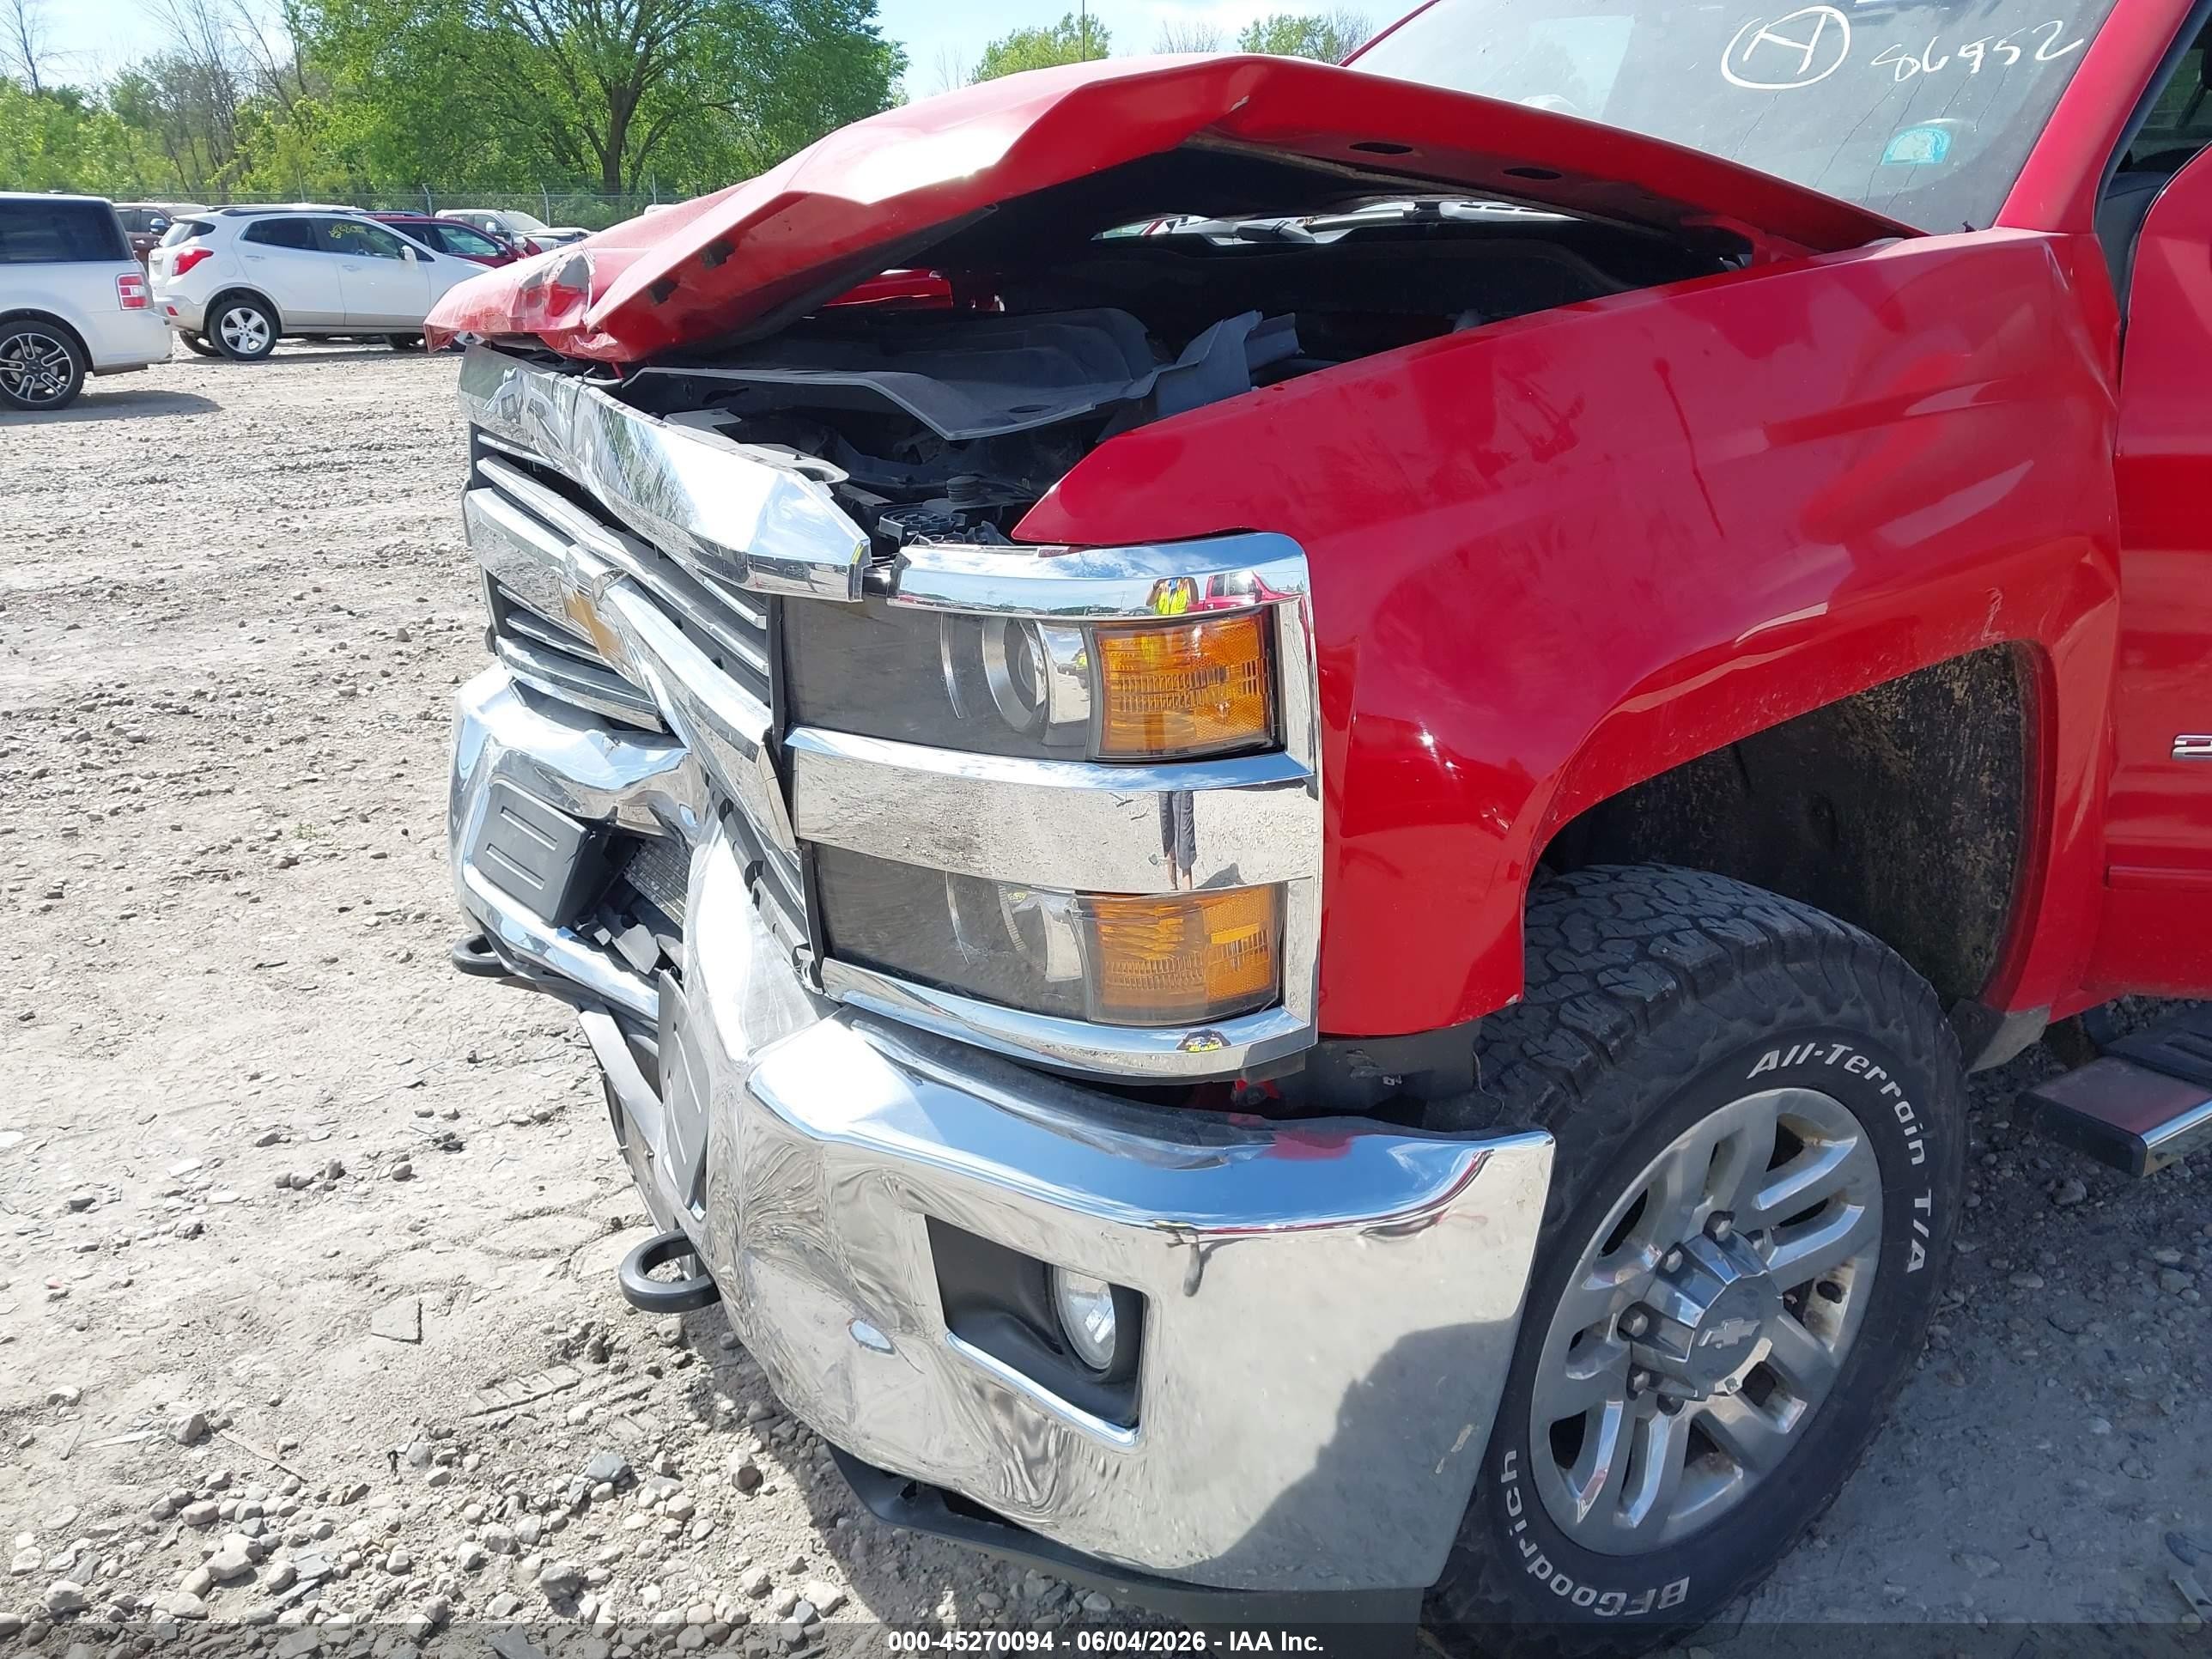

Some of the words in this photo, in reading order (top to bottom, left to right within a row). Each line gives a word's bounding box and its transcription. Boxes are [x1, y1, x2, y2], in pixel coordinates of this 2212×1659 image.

[1746, 1042, 1926, 1166] All-Terrain
[1906, 1188, 1932, 1273] T/A
[1500, 1449, 1690, 1617] BFGoodrich
